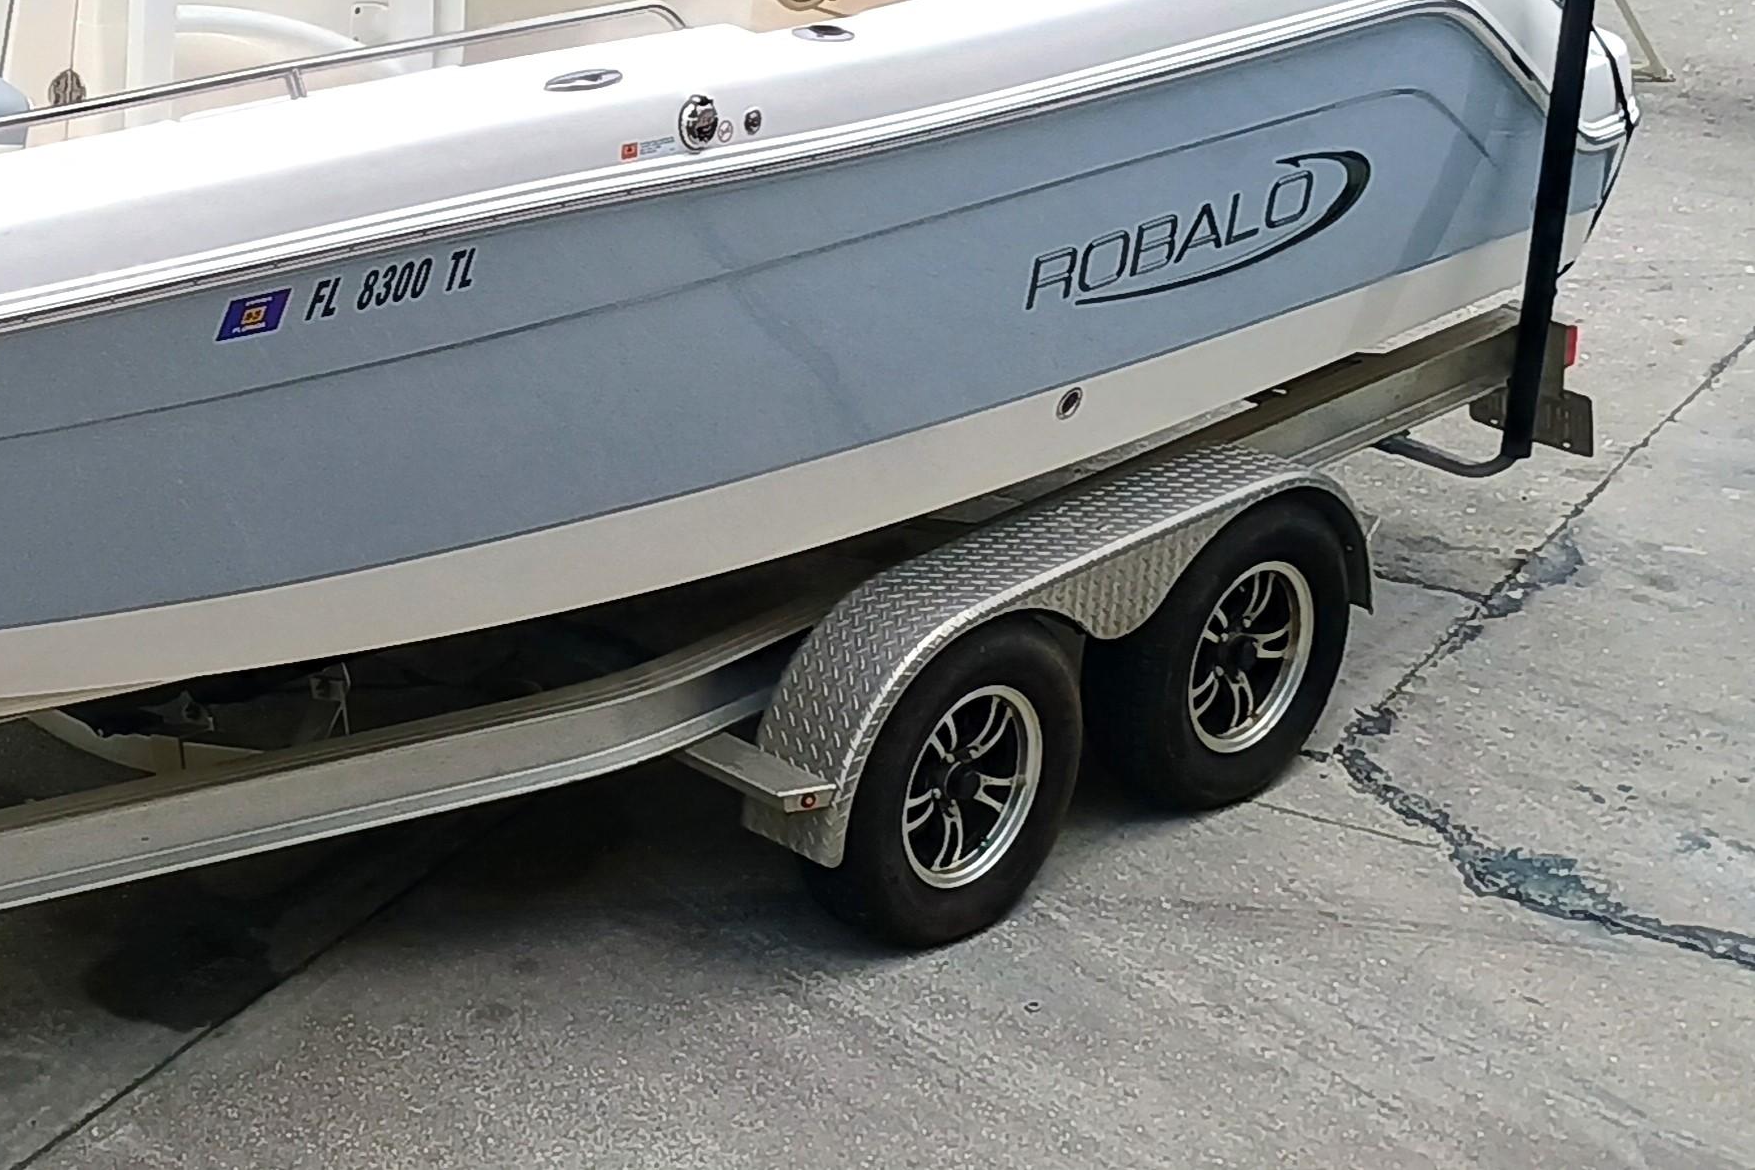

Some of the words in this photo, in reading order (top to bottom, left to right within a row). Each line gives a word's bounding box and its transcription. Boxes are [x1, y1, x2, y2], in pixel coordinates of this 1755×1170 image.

[305, 277, 342, 321] FL
[356, 258, 433, 311] 8300
[445, 247, 476, 292] TL
[1024, 168, 1314, 311] ROBALO
